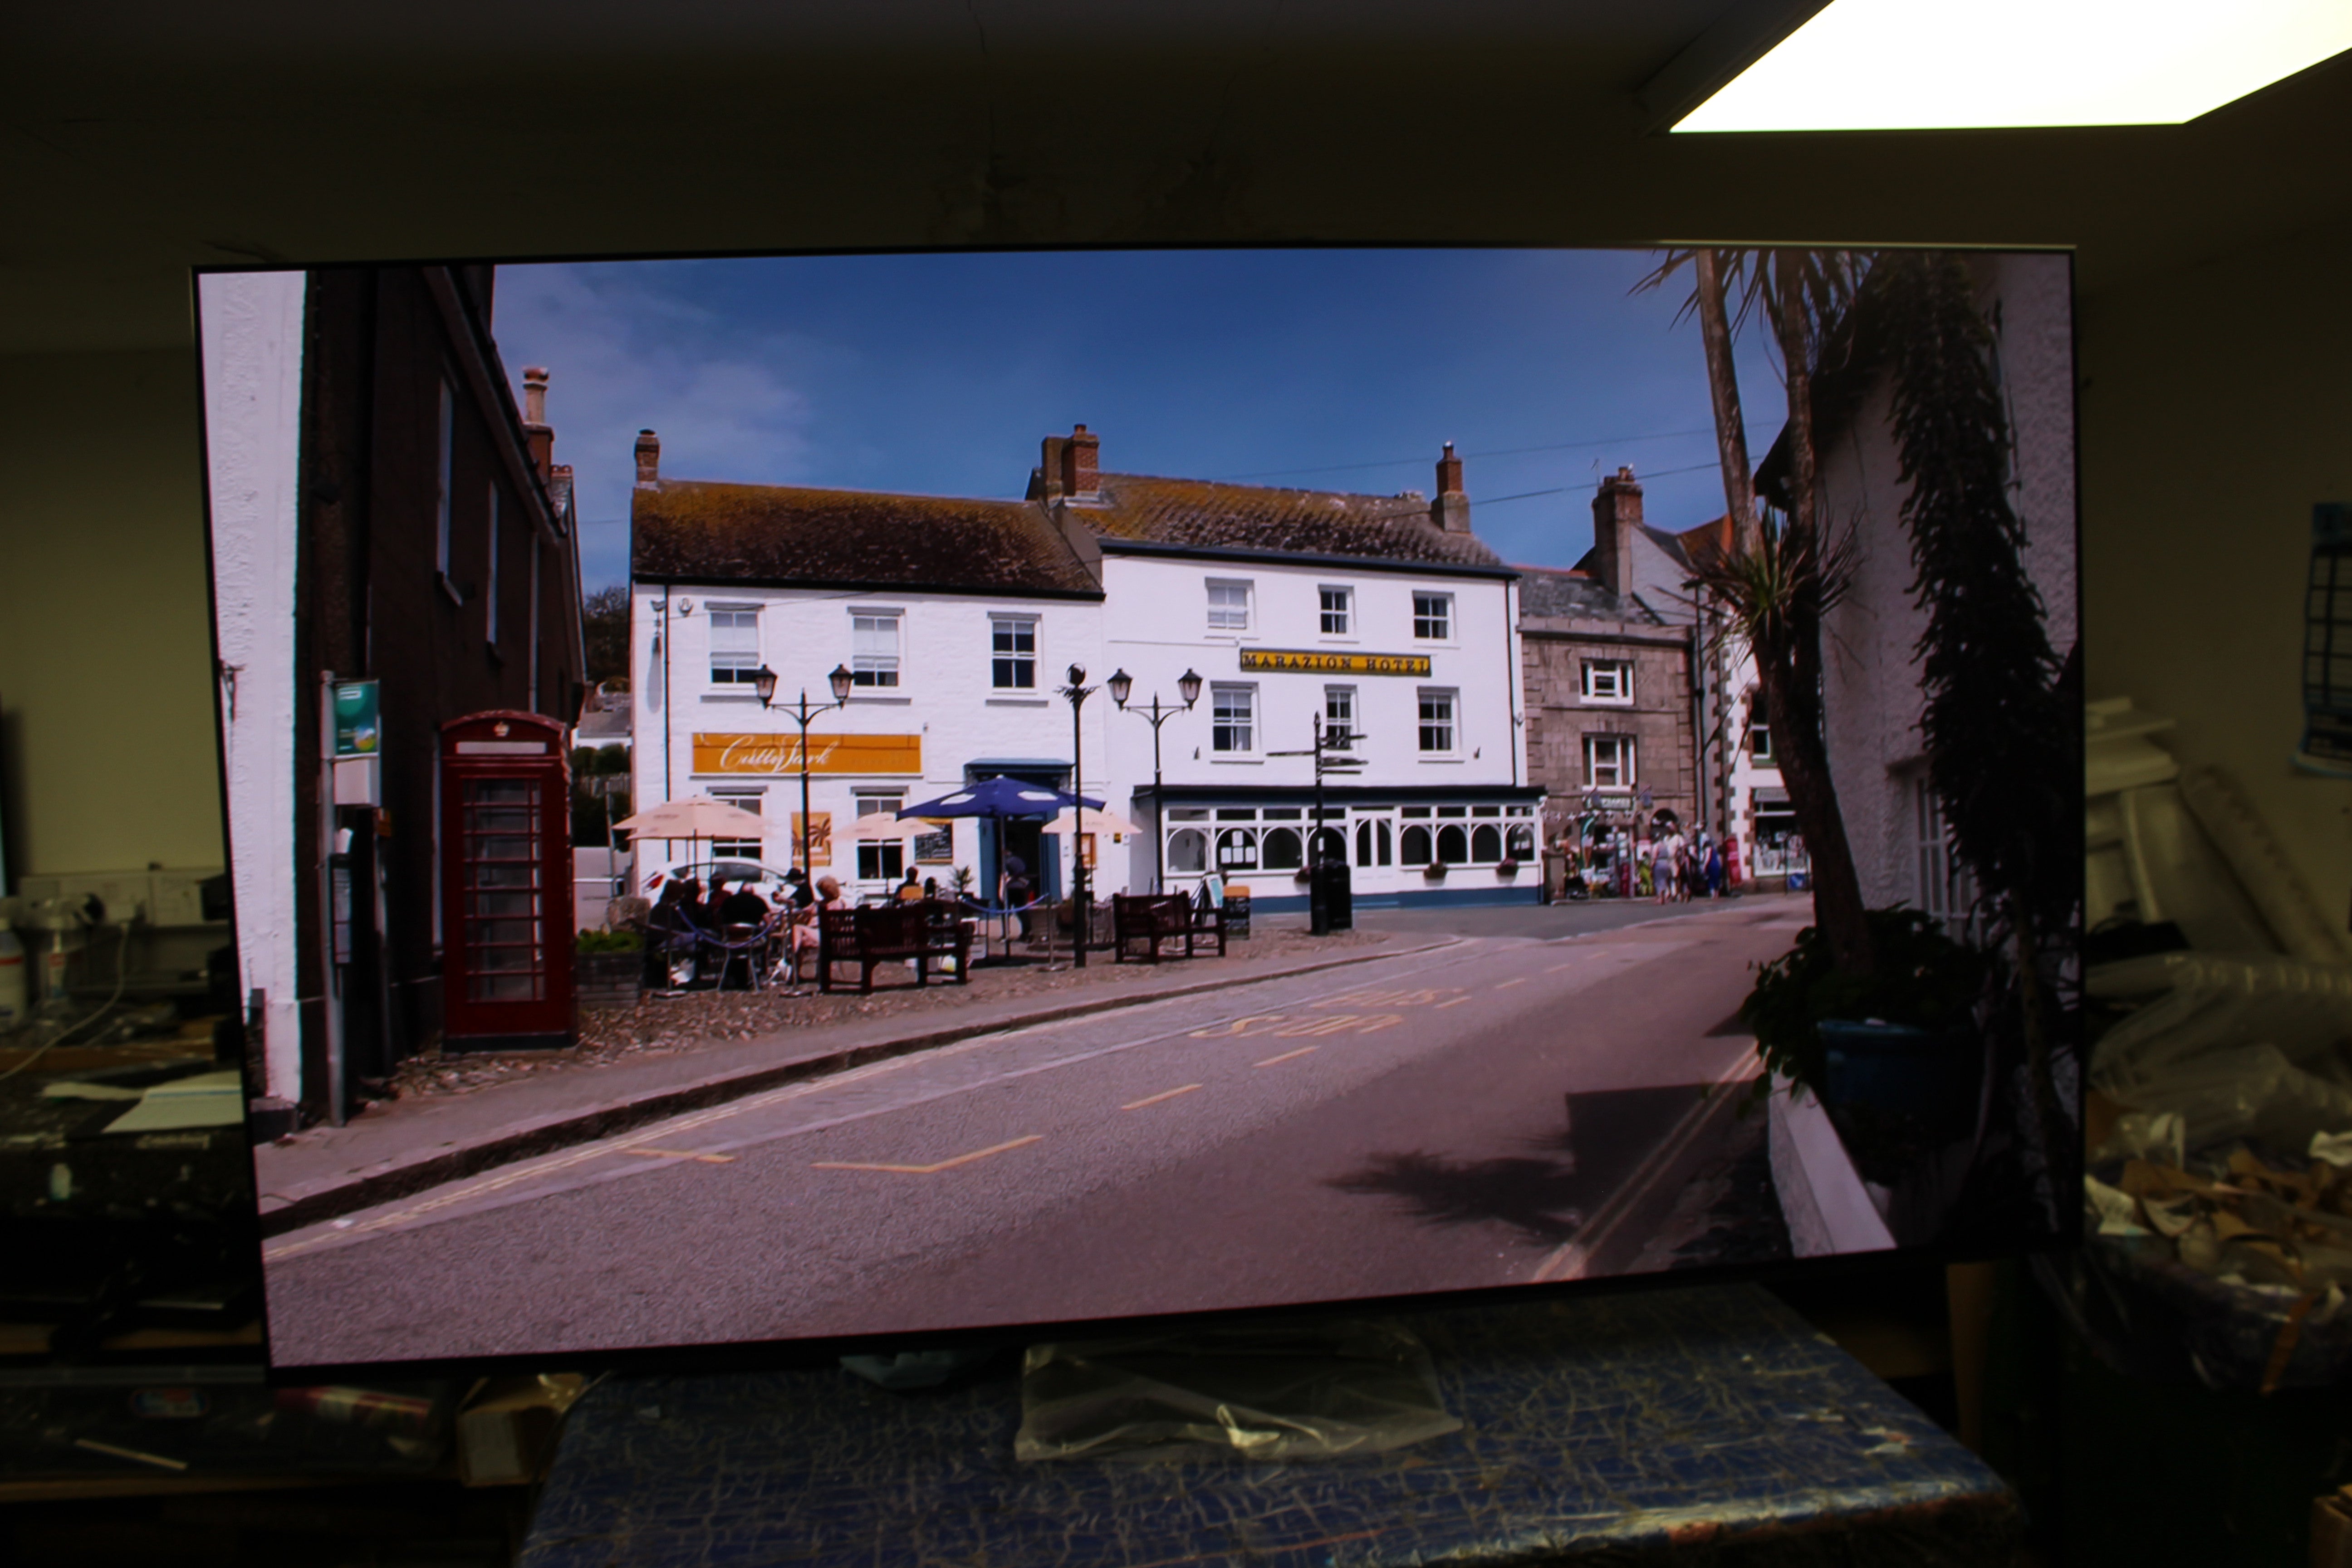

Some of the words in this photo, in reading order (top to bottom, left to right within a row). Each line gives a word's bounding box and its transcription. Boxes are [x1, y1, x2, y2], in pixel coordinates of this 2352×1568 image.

[1244, 653, 1352, 670] MARAZION
[1367, 657, 1429, 672] HOTEL
[720, 735, 786, 773] Cutty
